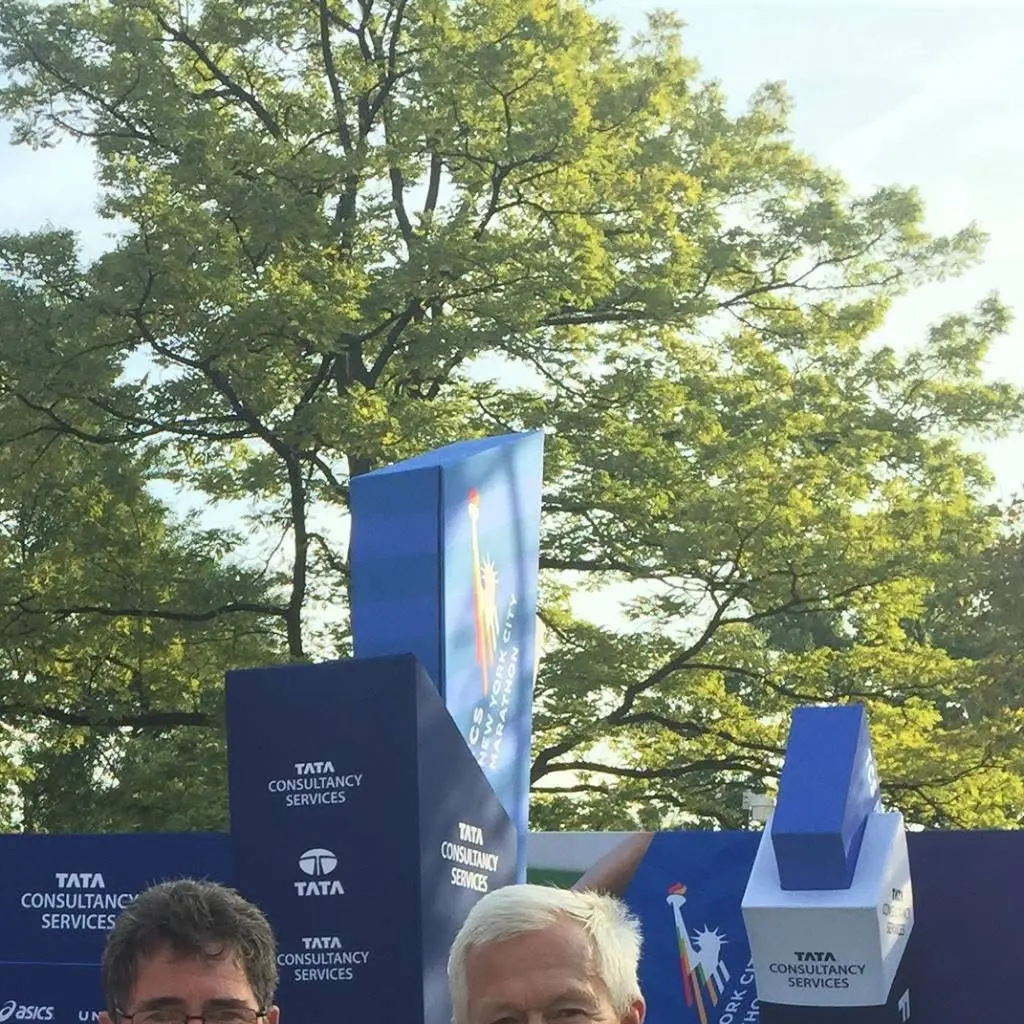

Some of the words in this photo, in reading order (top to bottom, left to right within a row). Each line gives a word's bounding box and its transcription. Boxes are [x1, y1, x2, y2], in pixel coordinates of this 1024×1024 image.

[489, 650, 507, 708] YORK
[502, 593, 517, 643] CITY
[489, 646, 519, 770] MARATHON
[294, 761, 334, 775] TATA
[268, 773, 363, 793] CONSULTANCY
[285, 791, 346, 807] SERVICES
[459, 822, 484, 846] TATA
[441, 841, 499, 872] CONSULTANCY
[55, 873, 105, 888] TATA
[451, 867, 488, 892] SERVICES
[294, 880, 345, 896] TATA
[41, 913, 116, 929] SERVICES
[302, 936, 342, 949] TATA
[277, 951, 369, 966] CONSULTANCY
[793, 951, 836, 962] TATA
[294, 967, 354, 981] SERVICES
[769, 962, 866, 977] CONSULTANCY
[787, 976, 850, 989] SERVICES
[15, 1006, 54, 1021] asics
